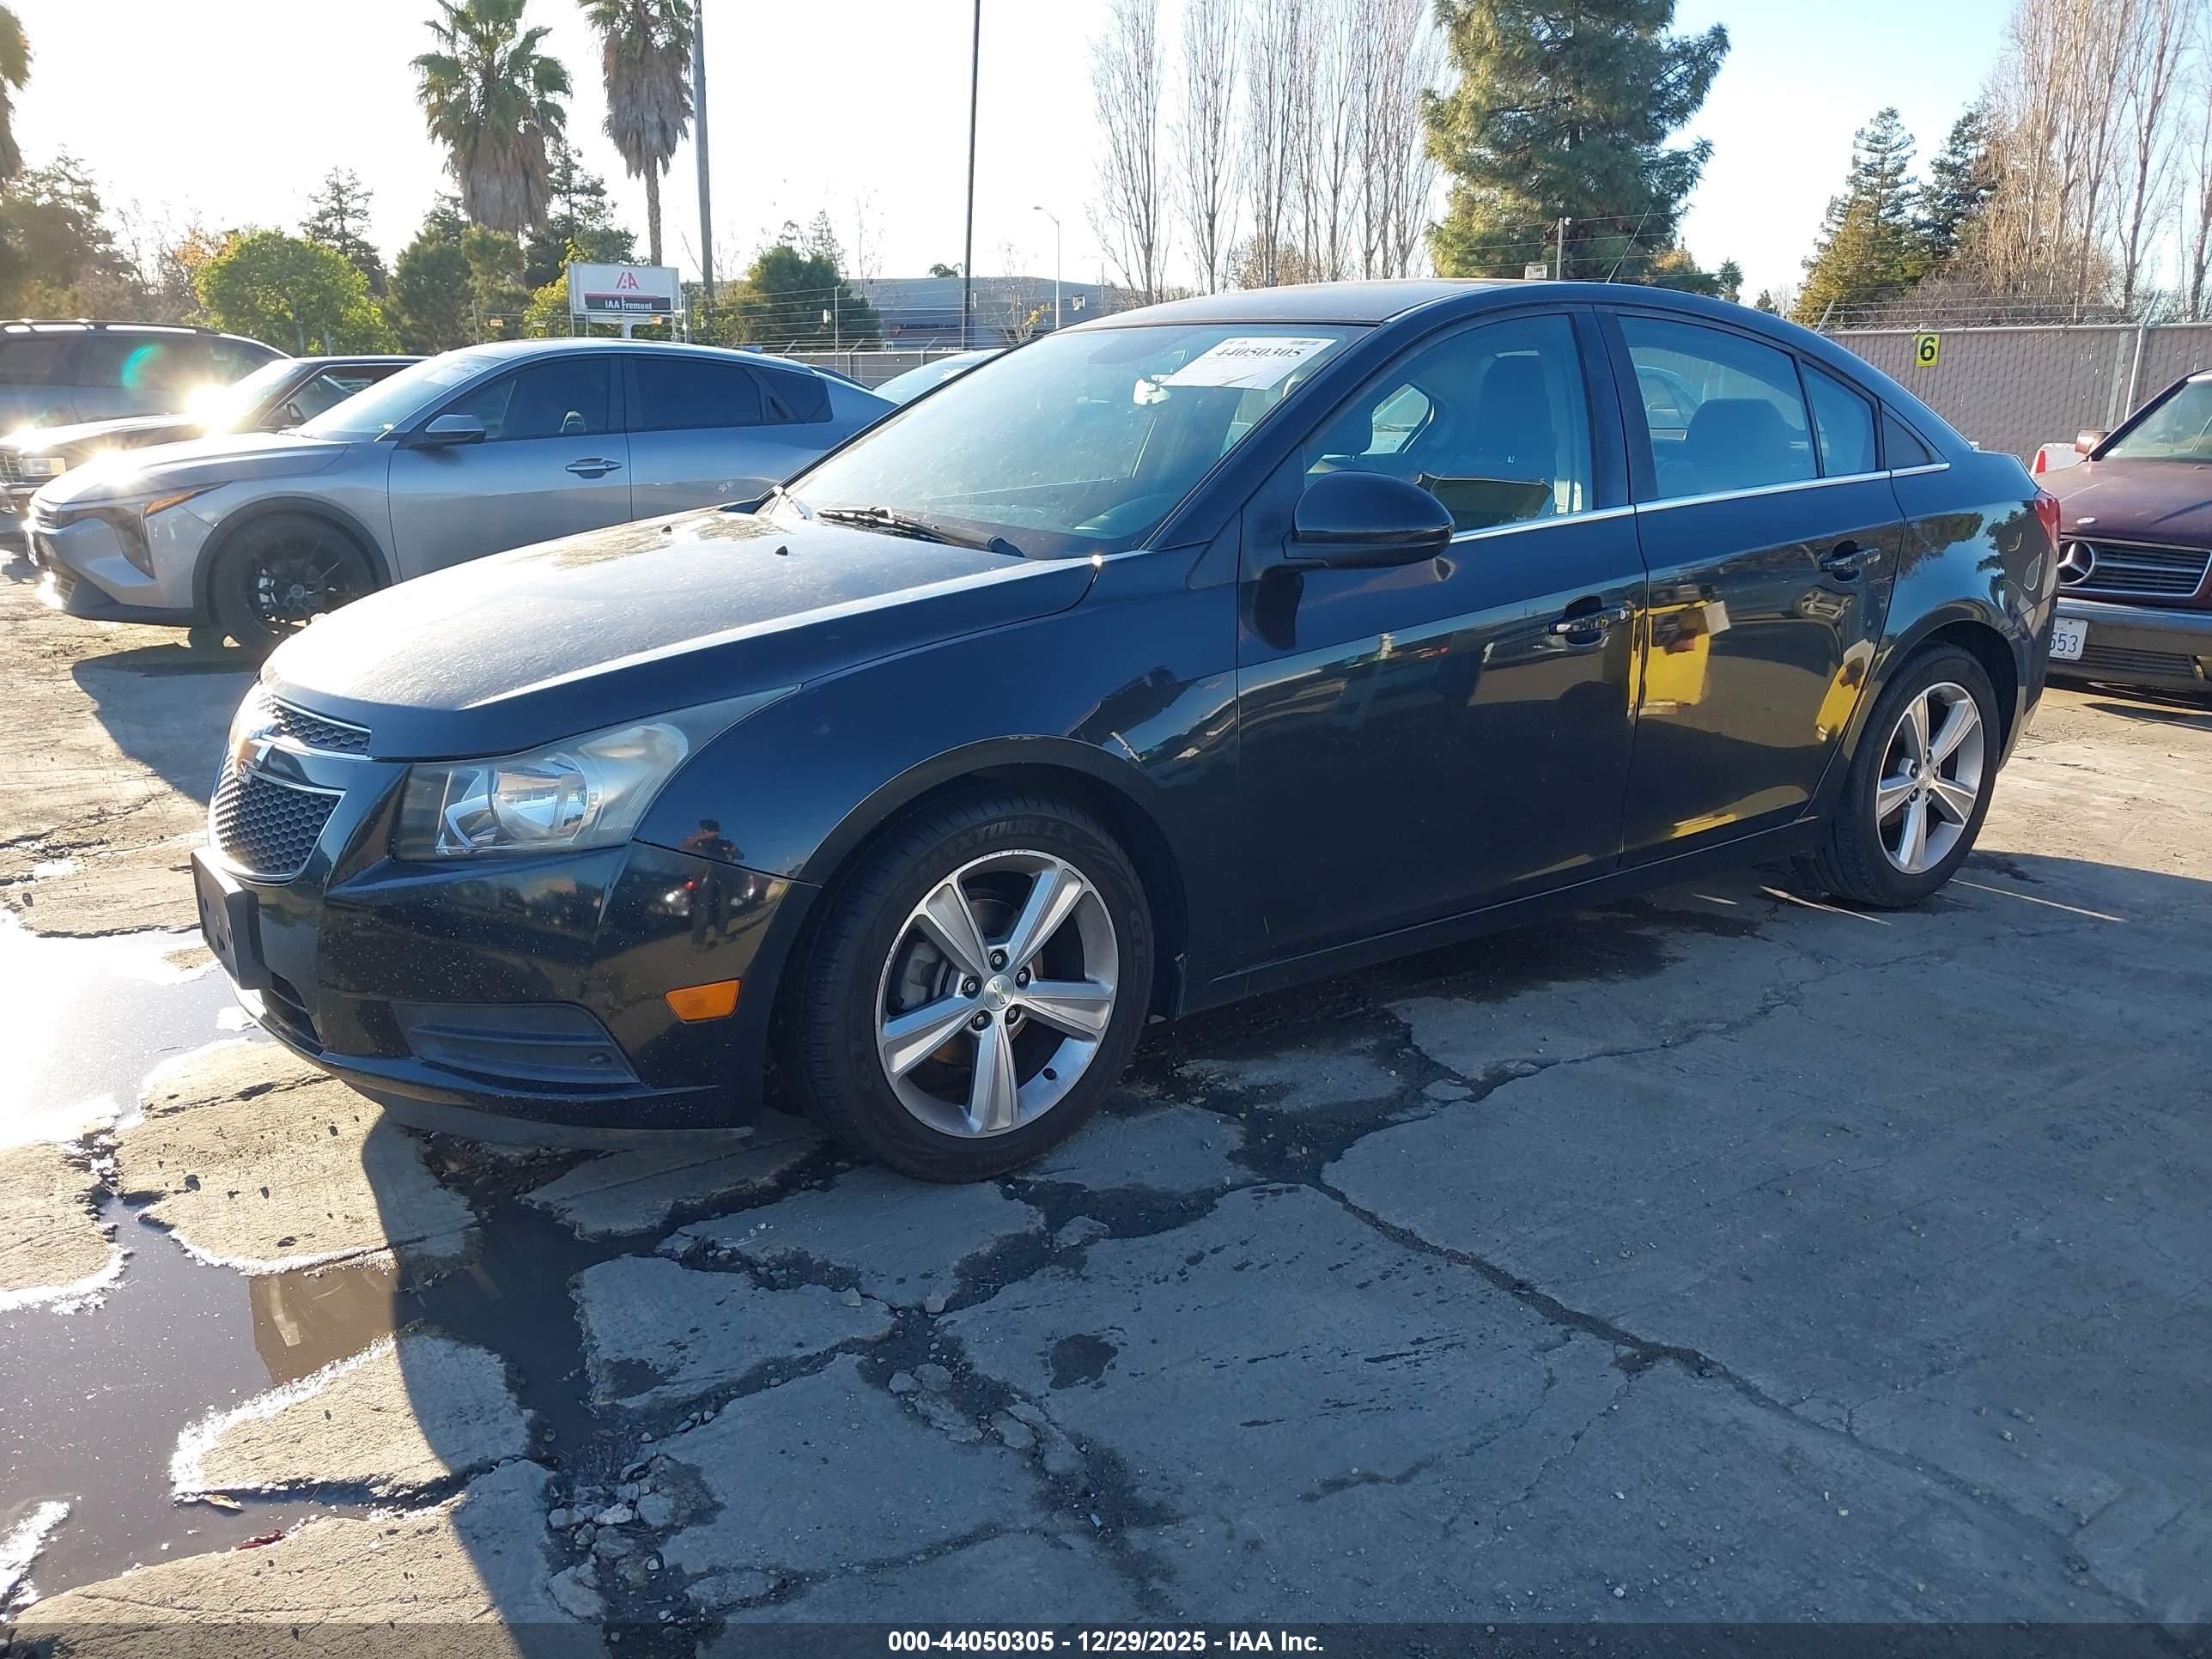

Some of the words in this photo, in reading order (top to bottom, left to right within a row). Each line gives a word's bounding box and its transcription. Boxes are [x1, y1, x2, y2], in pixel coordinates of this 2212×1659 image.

[605, 300, 620, 309] IAA
[622, 301, 653, 310] Fremont
[1215, 347, 1307, 357] 44050305
[1920, 336, 1936, 362] 6
